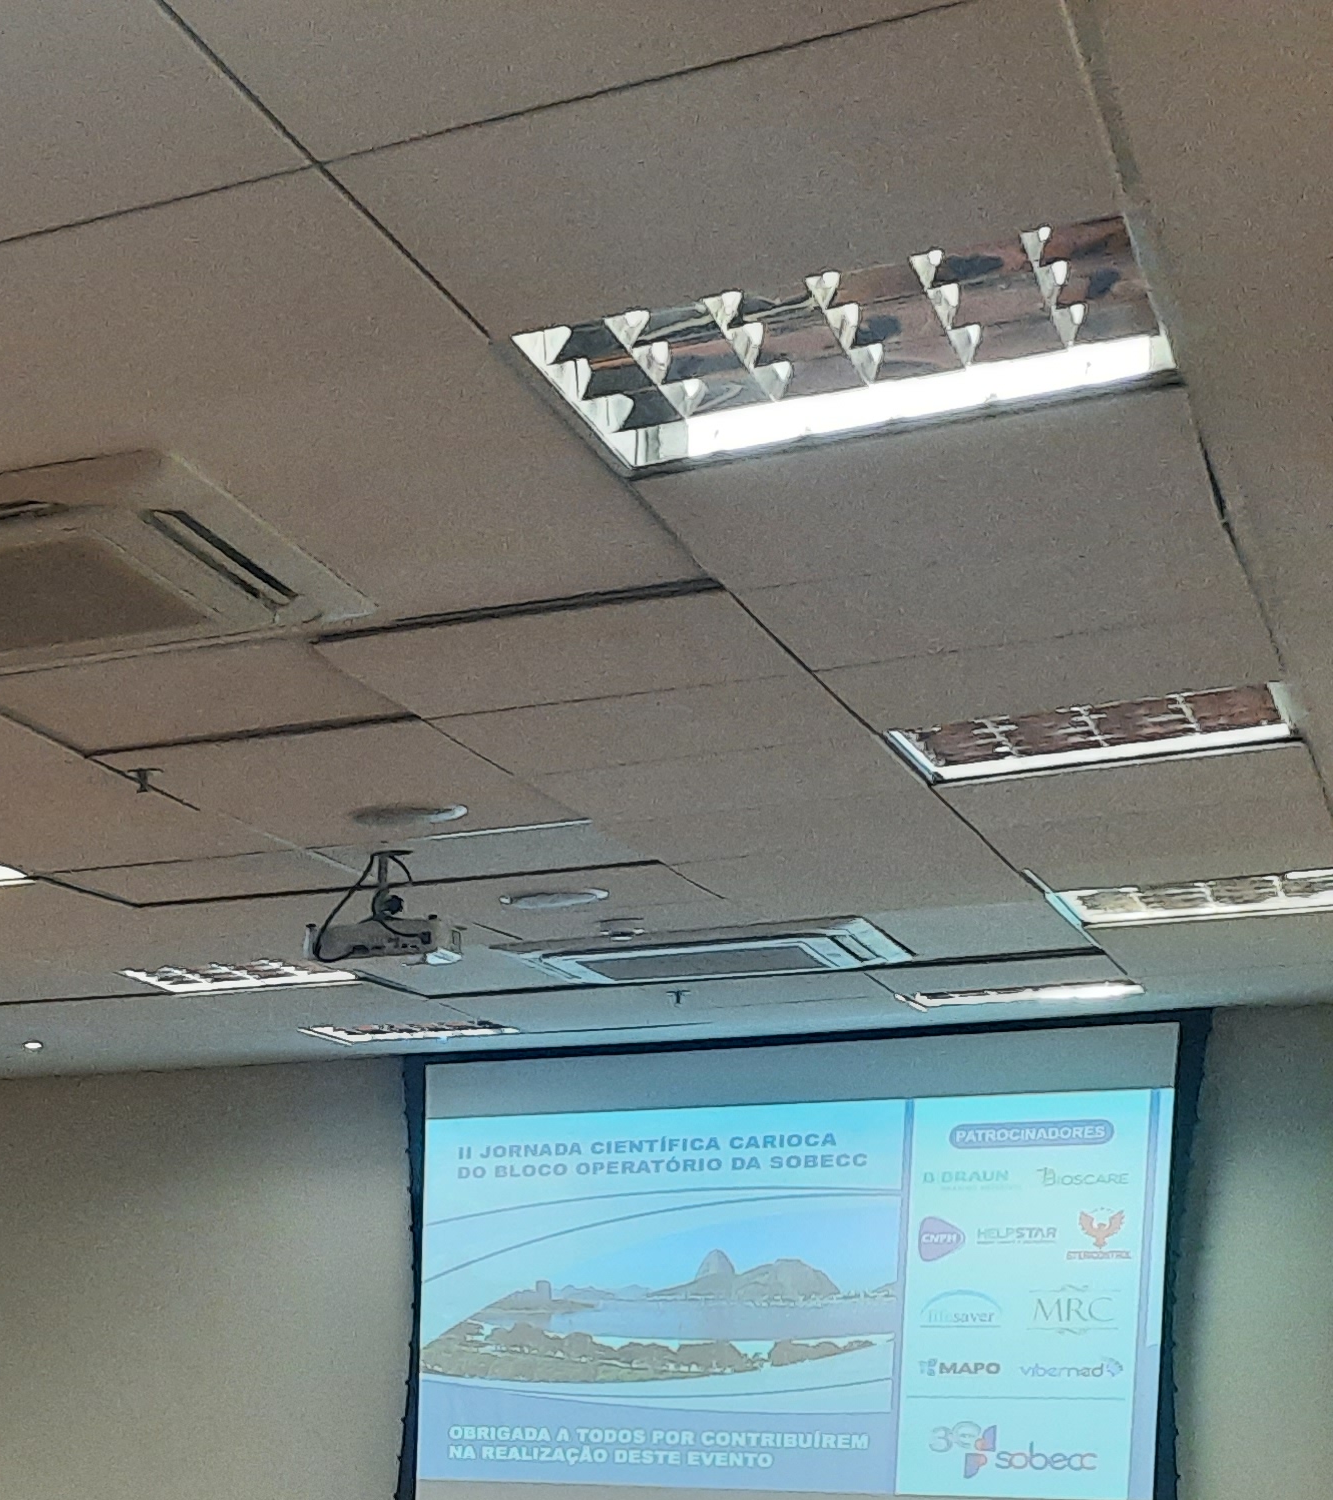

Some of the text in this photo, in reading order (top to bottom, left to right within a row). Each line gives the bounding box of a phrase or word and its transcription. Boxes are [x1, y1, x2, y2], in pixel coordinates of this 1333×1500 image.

[457, 1132, 837, 1160] II JORNADA CIENTÍFICA CARIOCA
[955, 1126, 1106, 1143] PATROCINADORES
[457, 1153, 868, 1179] DO BLOCO OPERATÓRIO DA SOBECC
[941, 1170, 1010, 1182] BRAUN
[977, 1226, 1057, 1240] HELPSTAR
[1033, 1297, 1115, 1323] MRC
[939, 1361, 1001, 1375] MAPO
[448, 1425, 870, 1450] OBRIGADA A TODOS POR CONTRIBUÍREM
[448, 1445, 774, 1468] NA REALIZAÇÃO DESTE EVENTO
[995, 1441, 1098, 1471] sobecc
